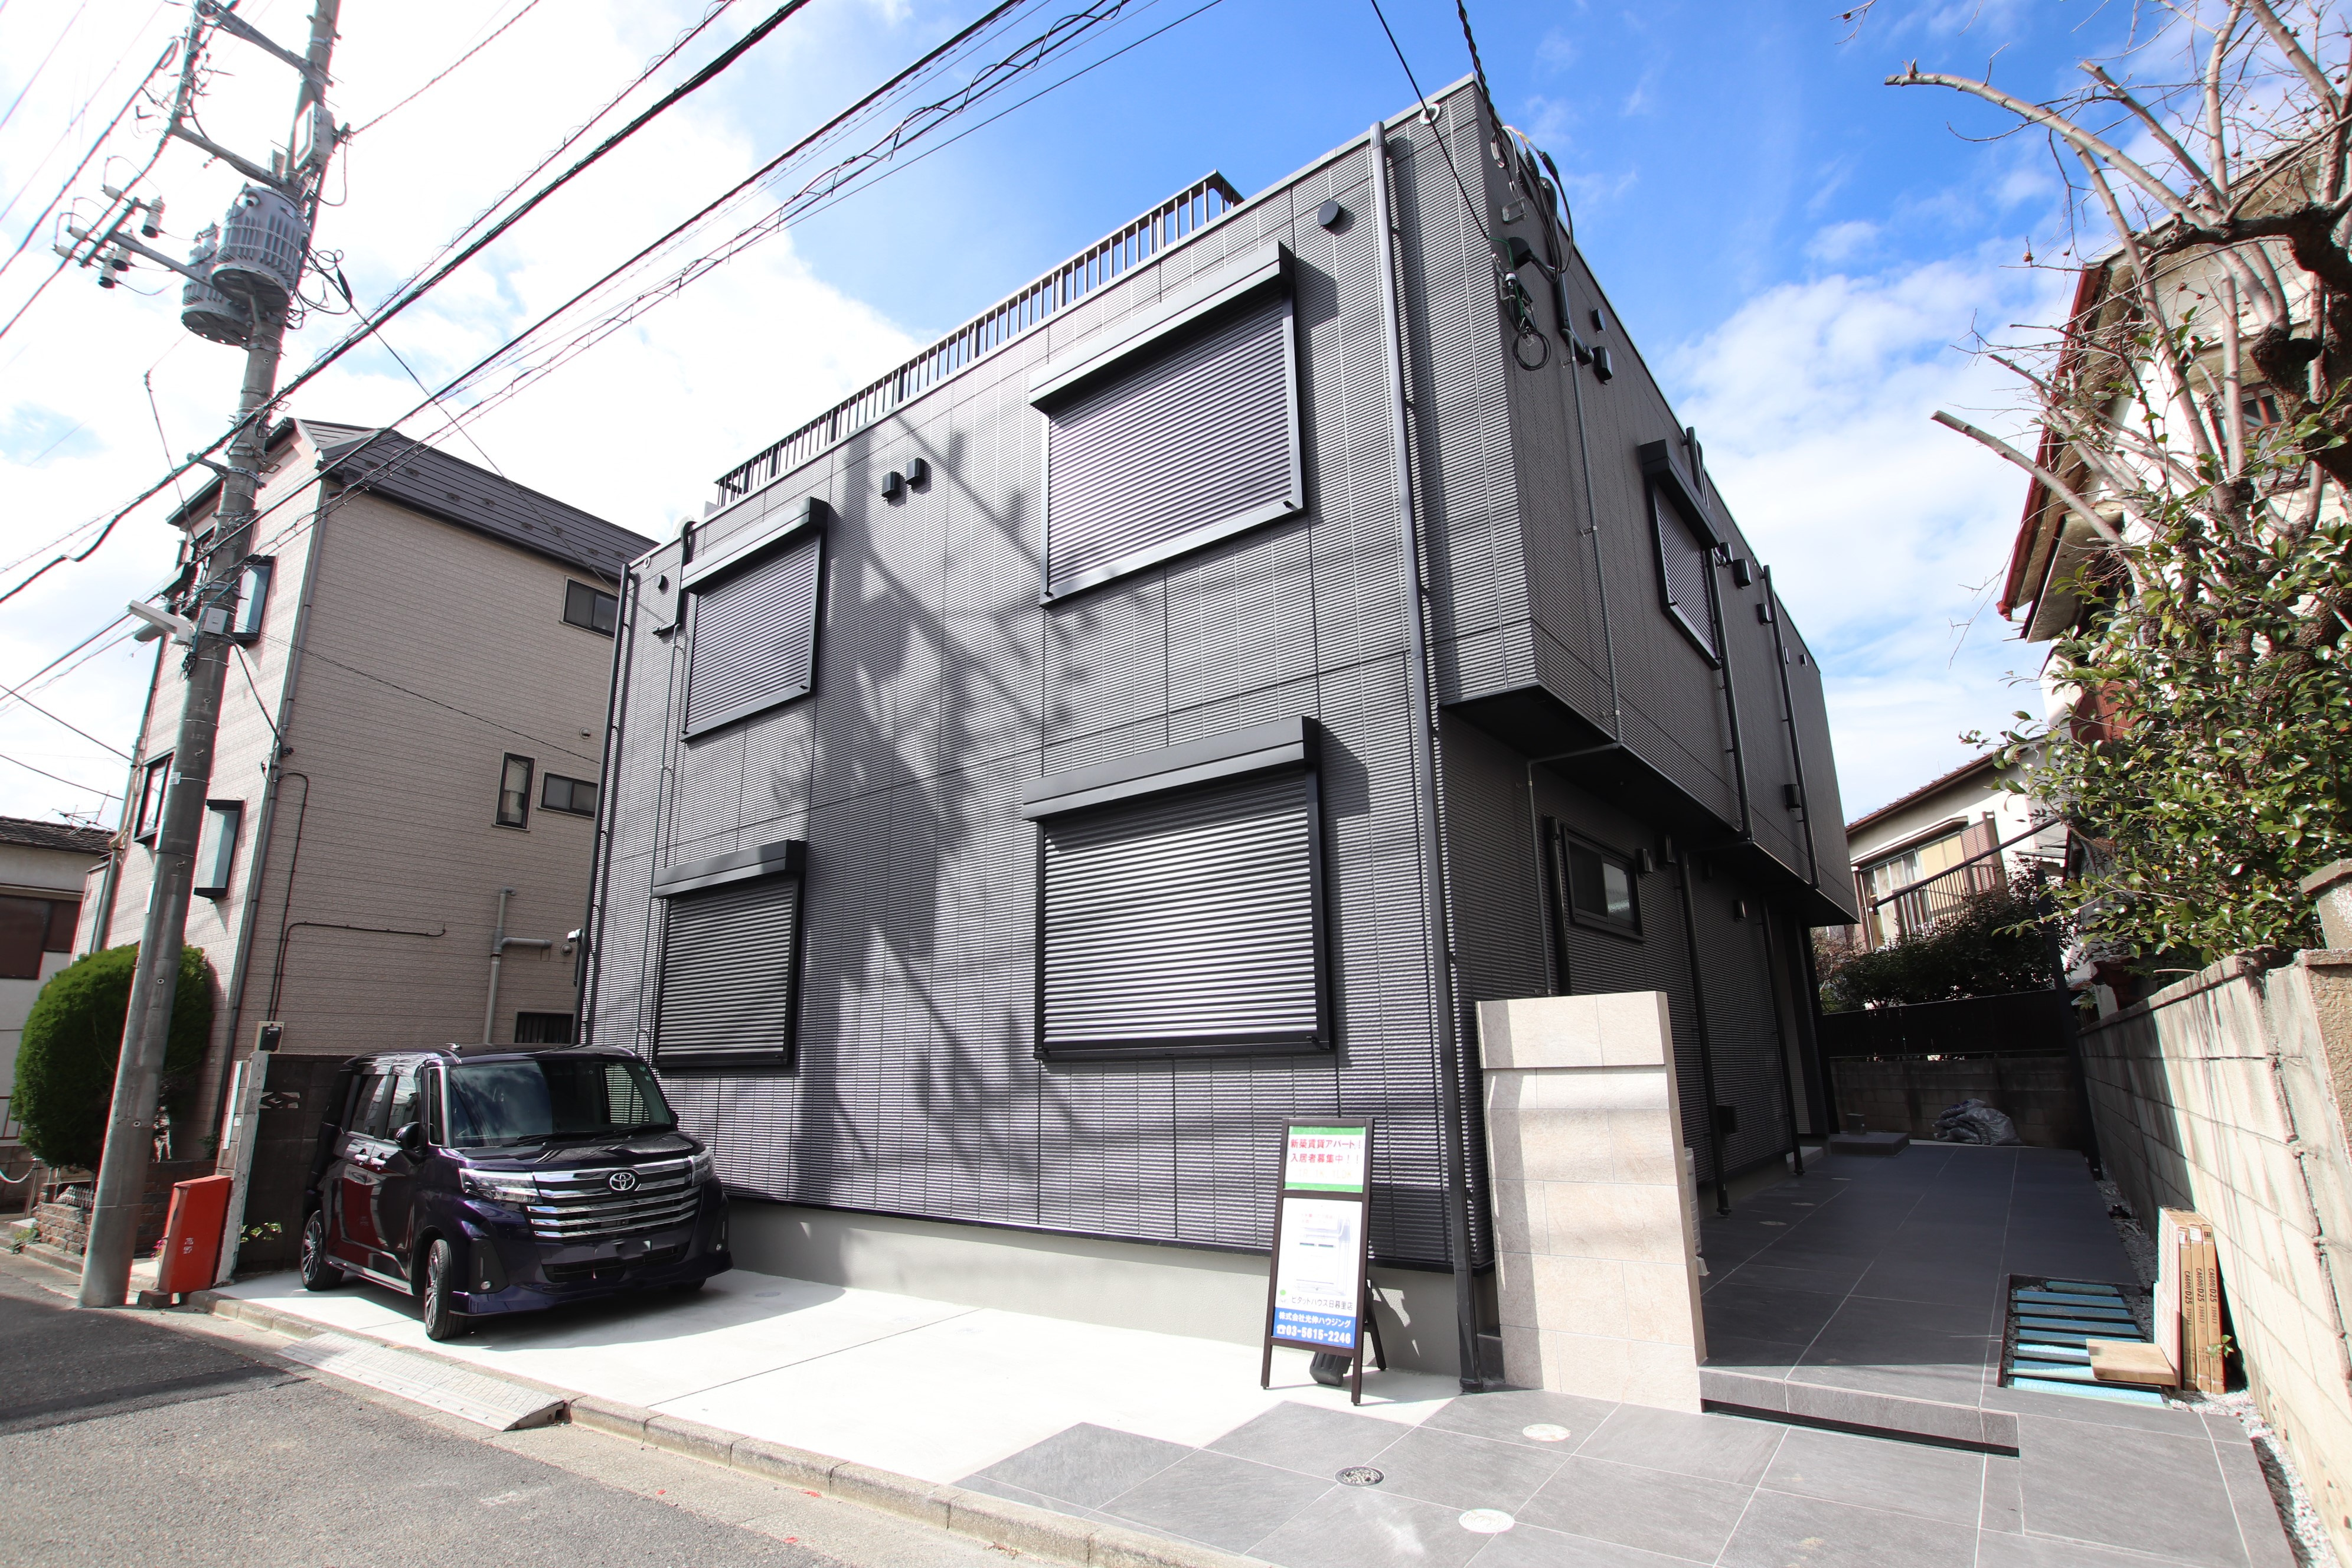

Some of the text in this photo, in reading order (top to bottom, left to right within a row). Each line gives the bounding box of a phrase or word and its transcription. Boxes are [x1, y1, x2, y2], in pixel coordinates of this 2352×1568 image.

[2184, 1270, 2193, 1305] CA600/D25
[2196, 1268, 2205, 1302] CA600/D25
[2208, 1268, 2217, 1303] CA600/D25
